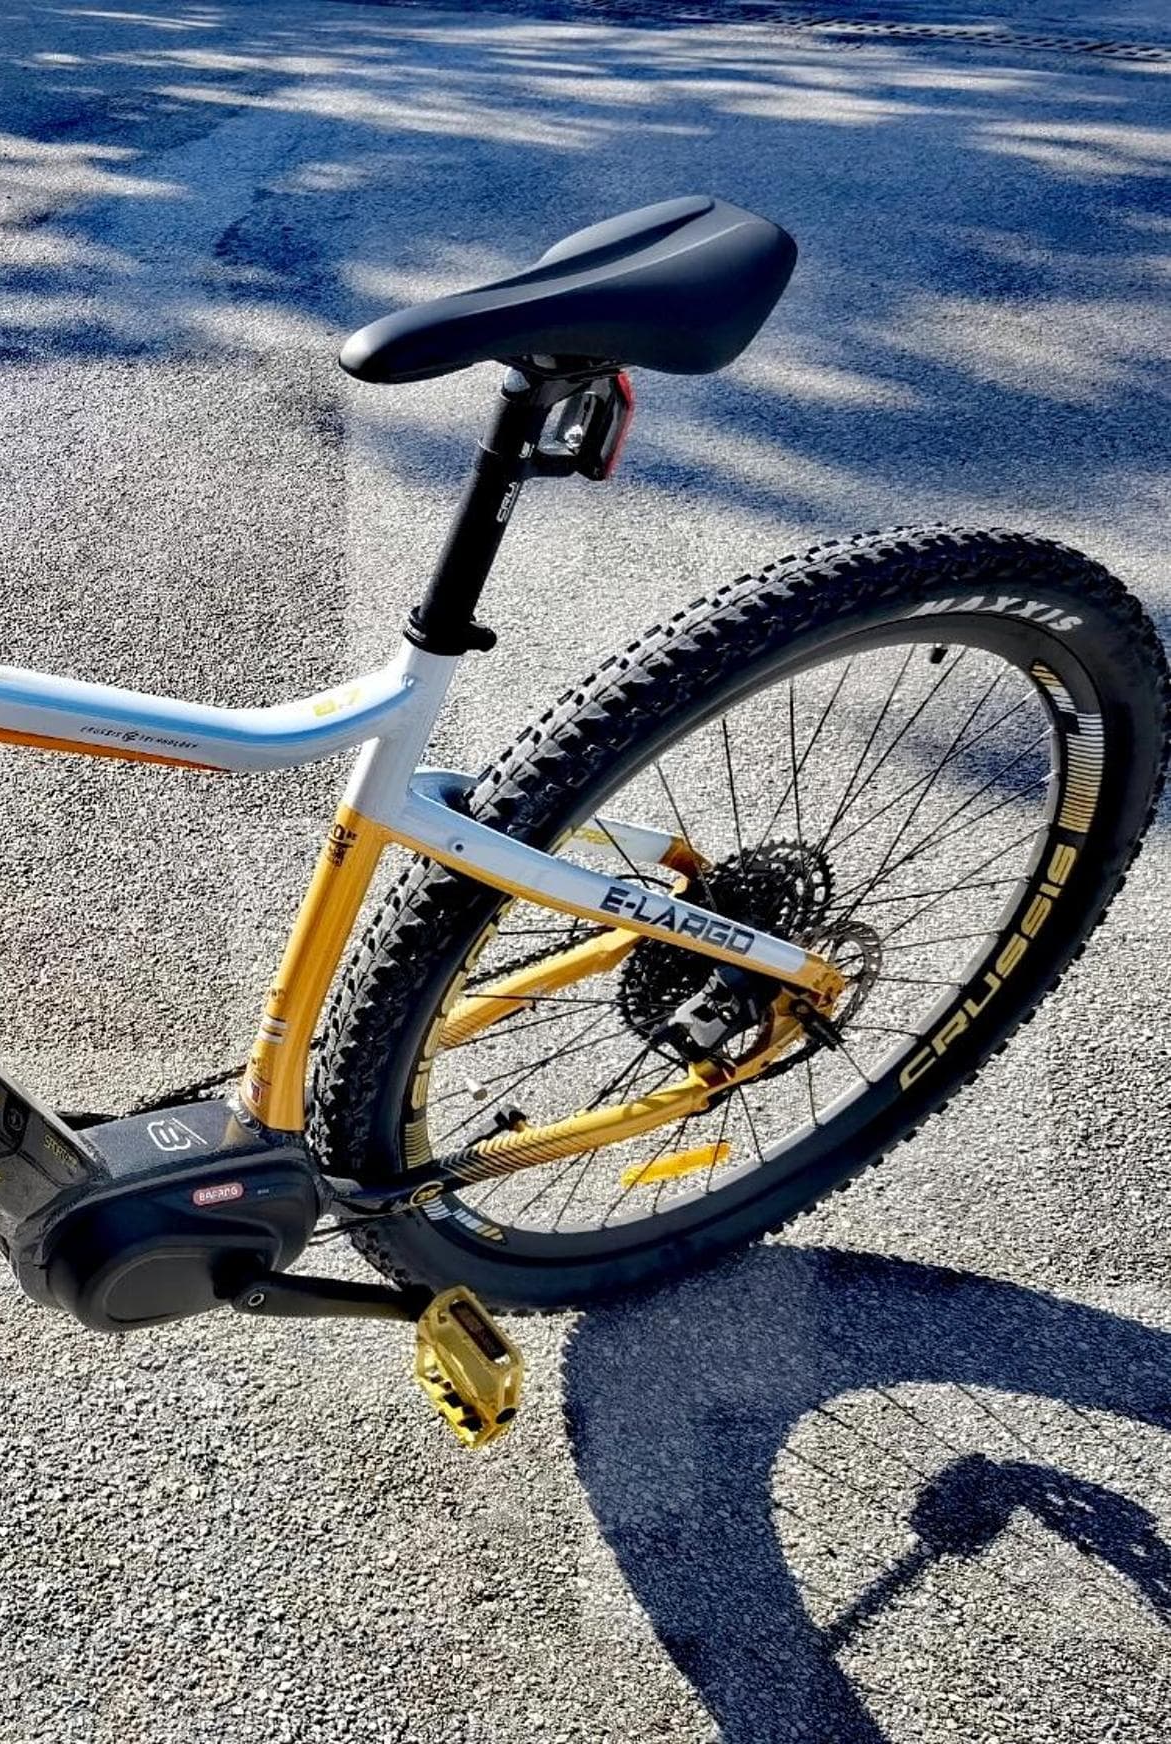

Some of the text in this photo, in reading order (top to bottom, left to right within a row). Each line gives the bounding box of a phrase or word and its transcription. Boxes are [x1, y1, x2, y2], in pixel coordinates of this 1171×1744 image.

[903, 595, 1084, 632] MAXXIS
[599, 886, 755, 955] E-LARGO
[898, 843, 1077, 1091] CRUSSIS
